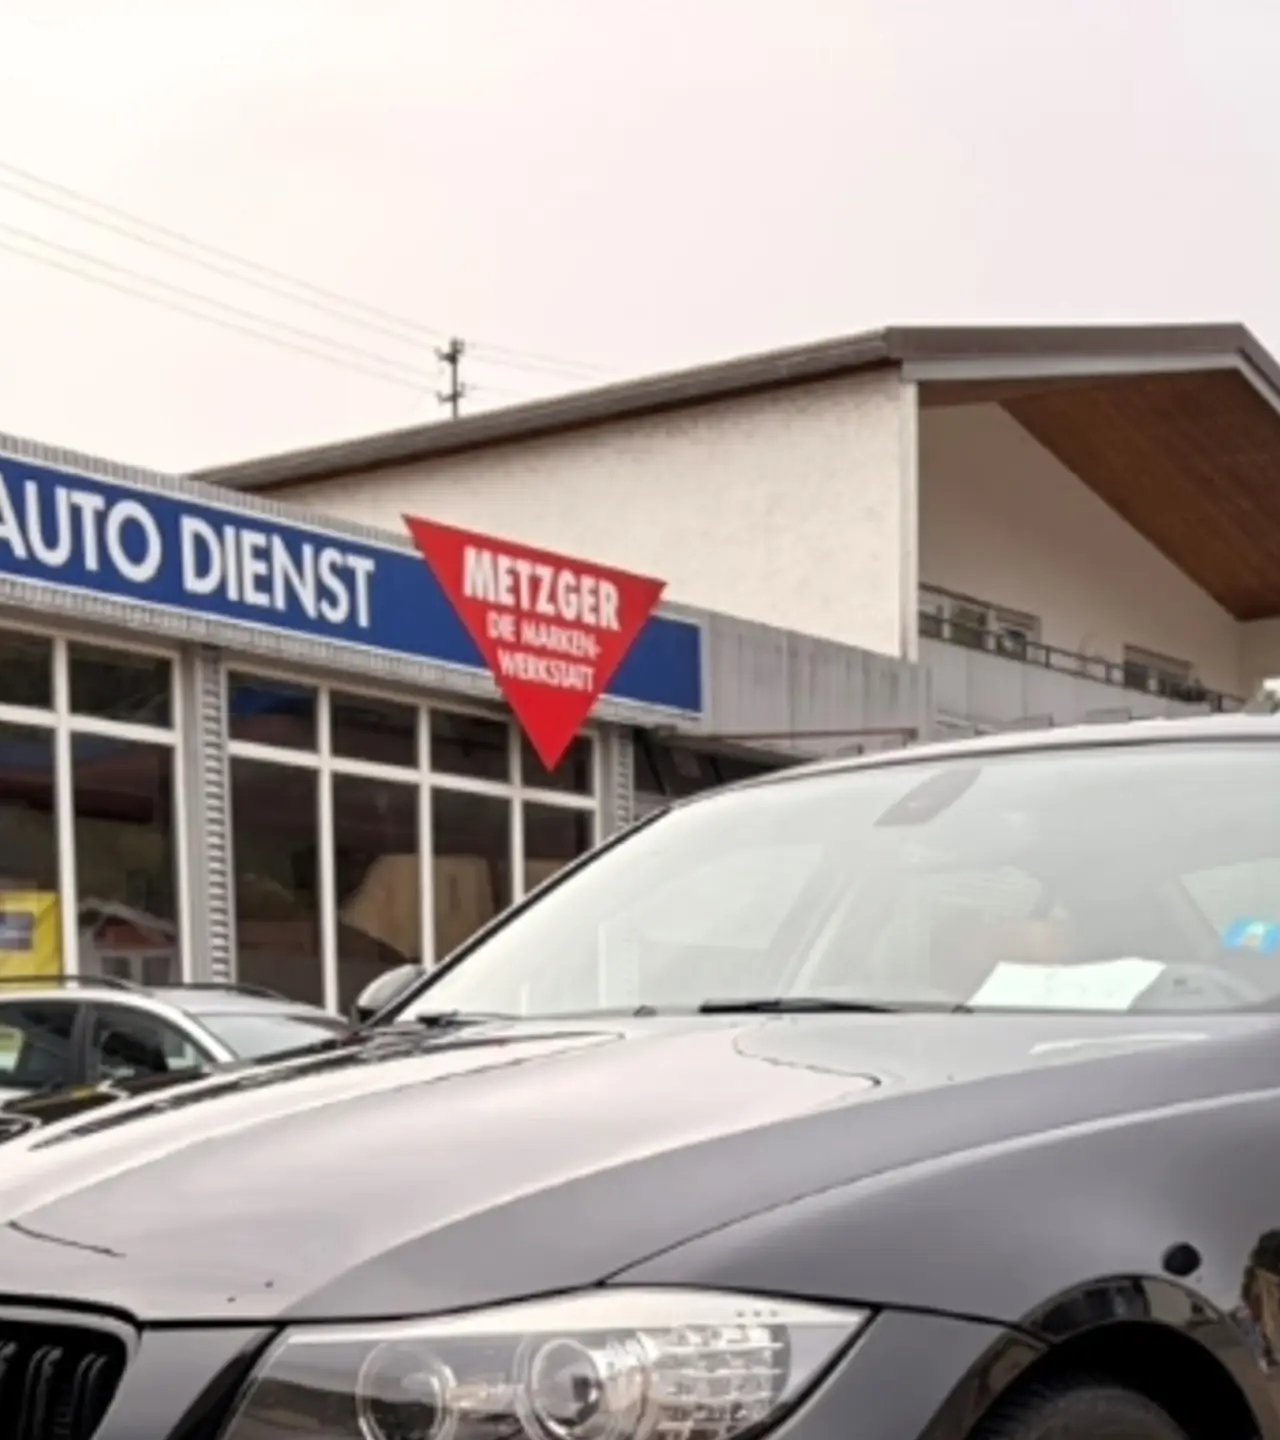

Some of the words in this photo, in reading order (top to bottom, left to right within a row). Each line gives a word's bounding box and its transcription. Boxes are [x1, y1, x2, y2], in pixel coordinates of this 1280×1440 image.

[180, 514, 375, 628] DIENST
[462, 545, 621, 632] METZGER
[486, 610, 517, 642] DIE
[497, 648, 596, 692] WERKSTATT
